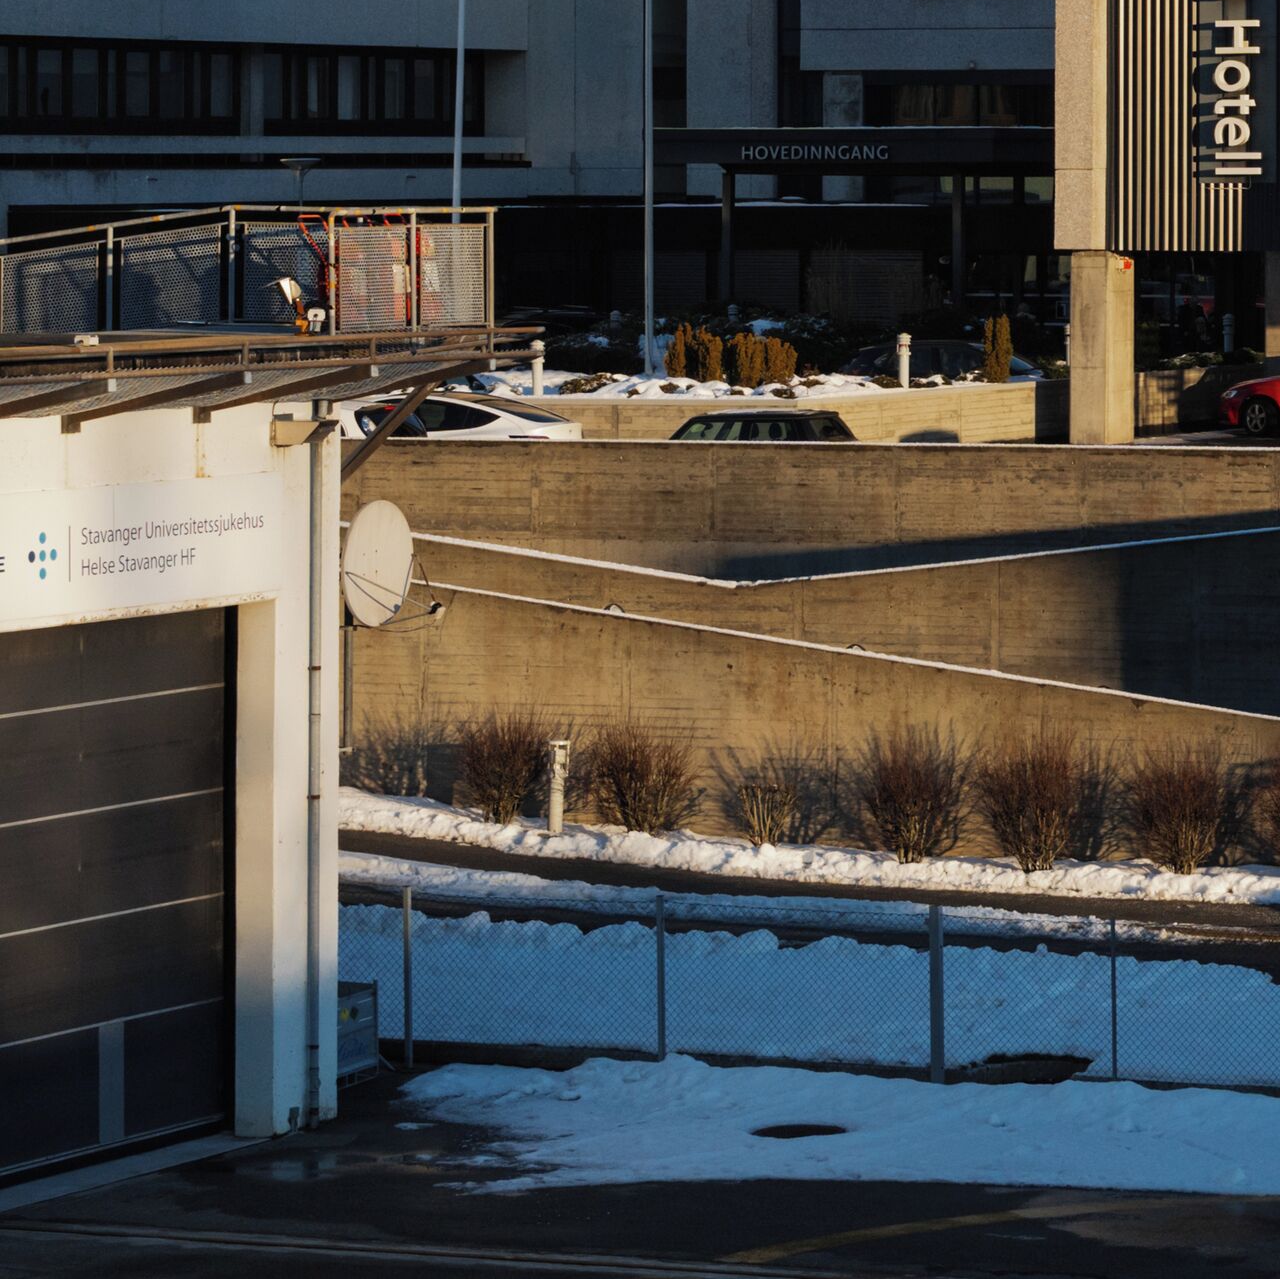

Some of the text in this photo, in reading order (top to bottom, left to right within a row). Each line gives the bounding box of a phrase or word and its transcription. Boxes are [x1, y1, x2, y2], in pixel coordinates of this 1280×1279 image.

[1214, 20, 1263, 176] Hotell
[742, 145, 889, 160] HOVEDINNGANG
[81, 512, 264, 546] Stavanger Universitetssjukehus
[81, 547, 196, 576] Helse Stavanger HF
